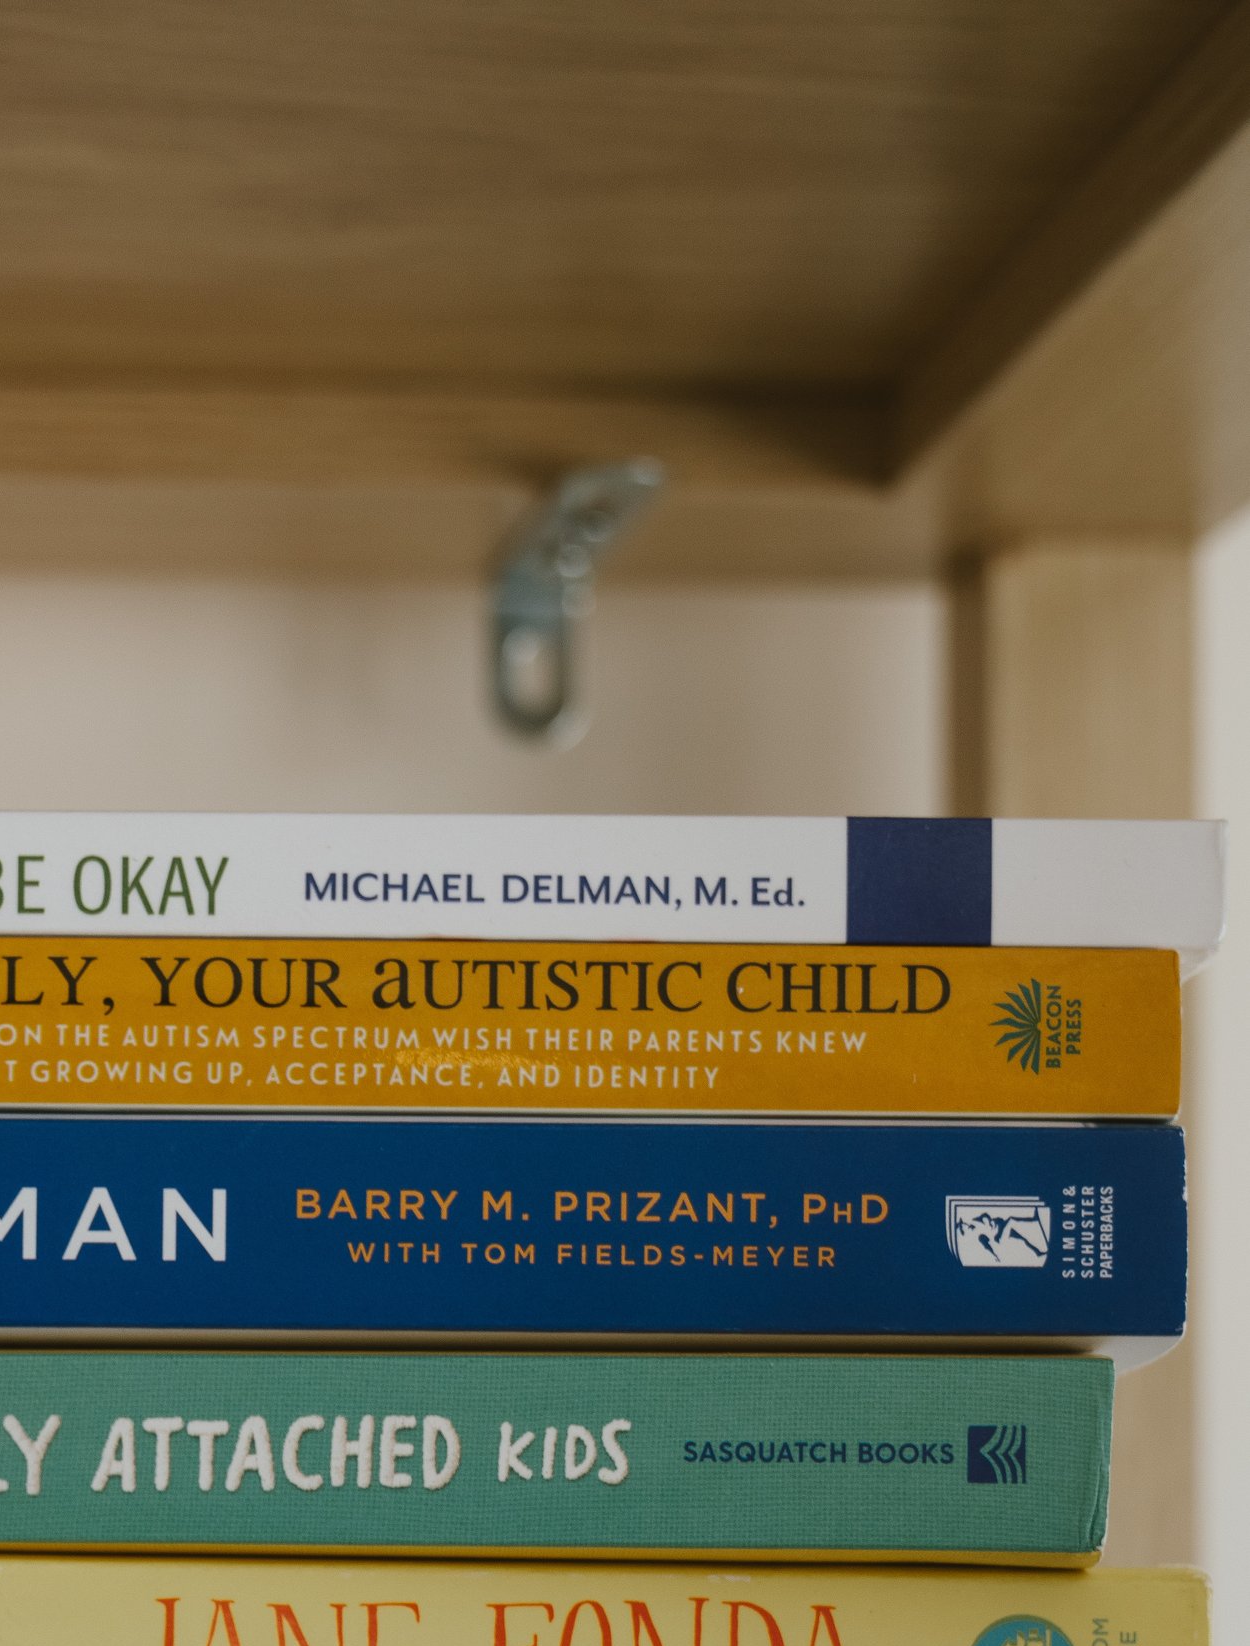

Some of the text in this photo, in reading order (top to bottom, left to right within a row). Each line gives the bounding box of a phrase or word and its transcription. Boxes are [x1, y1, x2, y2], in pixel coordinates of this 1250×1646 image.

[72, 854, 229, 916] OKAY
[304, 872, 805, 910] MICHAEL DELMAN, M. Ed.
[140, 956, 348, 1009] YOUR
[726, 960, 951, 1014] CHILD
[56, 1023, 109, 1047] THE
[122, 1024, 240, 1048] AUTISM
[253, 1025, 418, 1050] SPECTRUM
[432, 1027, 512, 1051] WISH
[525, 1027, 614, 1051] THEIR
[627, 1028, 763, 1054] PARENTS
[776, 1030, 867, 1054] KNEW
[1045, 985, 1063, 1069] BEACON
[1065, 998, 1083, 1055] PRESS
[30, 1059, 193, 1085] GROWING
[206, 1061, 252, 1087] UP,
[265, 1061, 485, 1090] ACCEPTANCE,
[497, 1063, 561, 1088] AND
[574, 1064, 719, 1089] IDENTITY
[296, 1188, 458, 1220] BARRY
[482, 1190, 530, 1221] M.
[554, 1190, 778, 1229] PRIZANT,
[1061, 1185, 1077, 1279] SIMON &
[1080, 1185, 1095, 1279] SCHUSTER
[1099, 1185, 1114, 1279] PAPERBACKS
[347, 1242, 835, 1267] WITH TOM FIELDS-MEYER
[90, 1414, 461, 1493] ATTACHED
[497, 1418, 632, 1484] KIDS
[683, 1440, 955, 1465] SASQUATCH BOOKS
